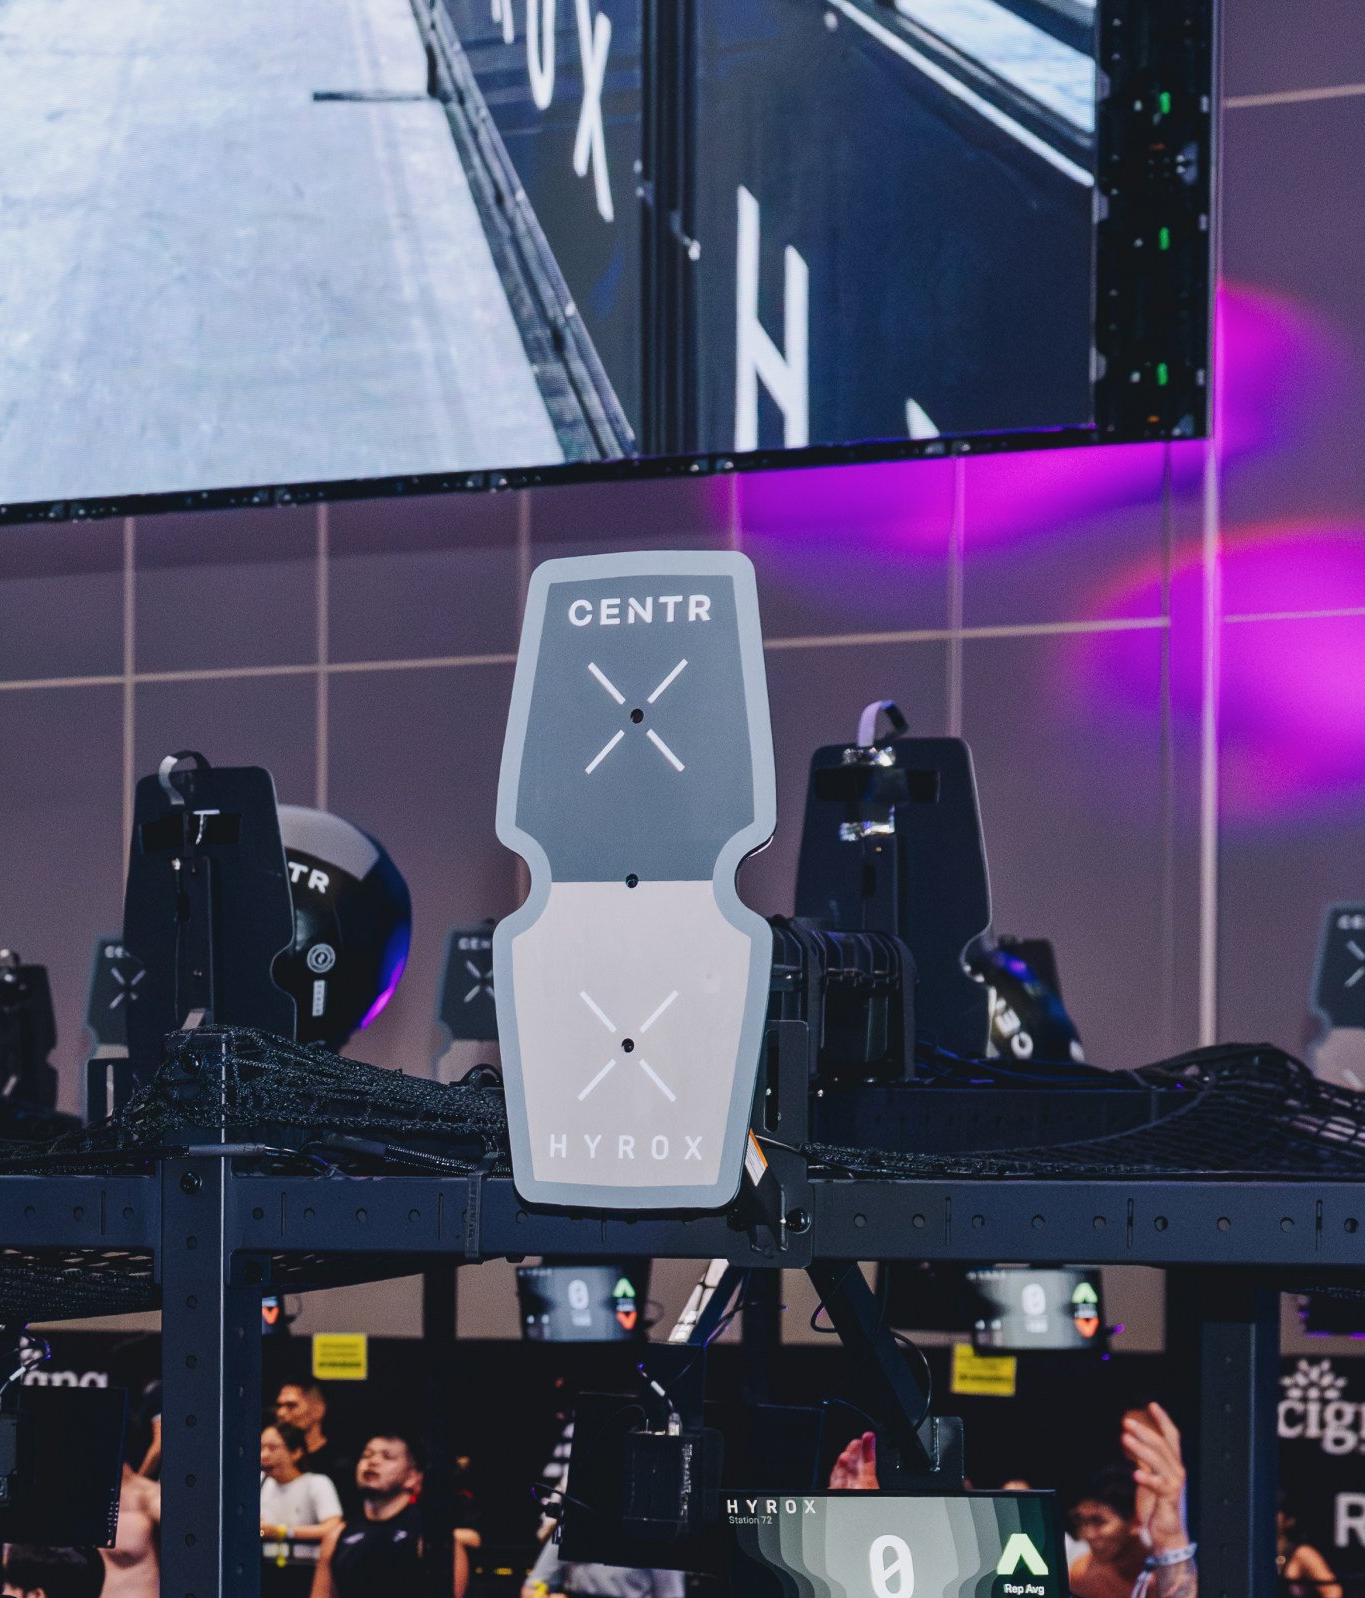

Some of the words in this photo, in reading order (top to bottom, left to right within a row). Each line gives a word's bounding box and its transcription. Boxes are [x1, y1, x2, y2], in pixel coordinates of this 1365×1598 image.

[569, 594, 711, 627] CENTR
[550, 1134, 703, 1161] HYROX
[1278, 1399, 1365, 1455] cig
[727, 1500, 816, 1514] HYROX
[727, 1515, 759, 1525] Station
[761, 1515, 773, 1525] 72
[1003, 1583, 1024, 1595] Rep
[1025, 1584, 1045, 1596] Avg
